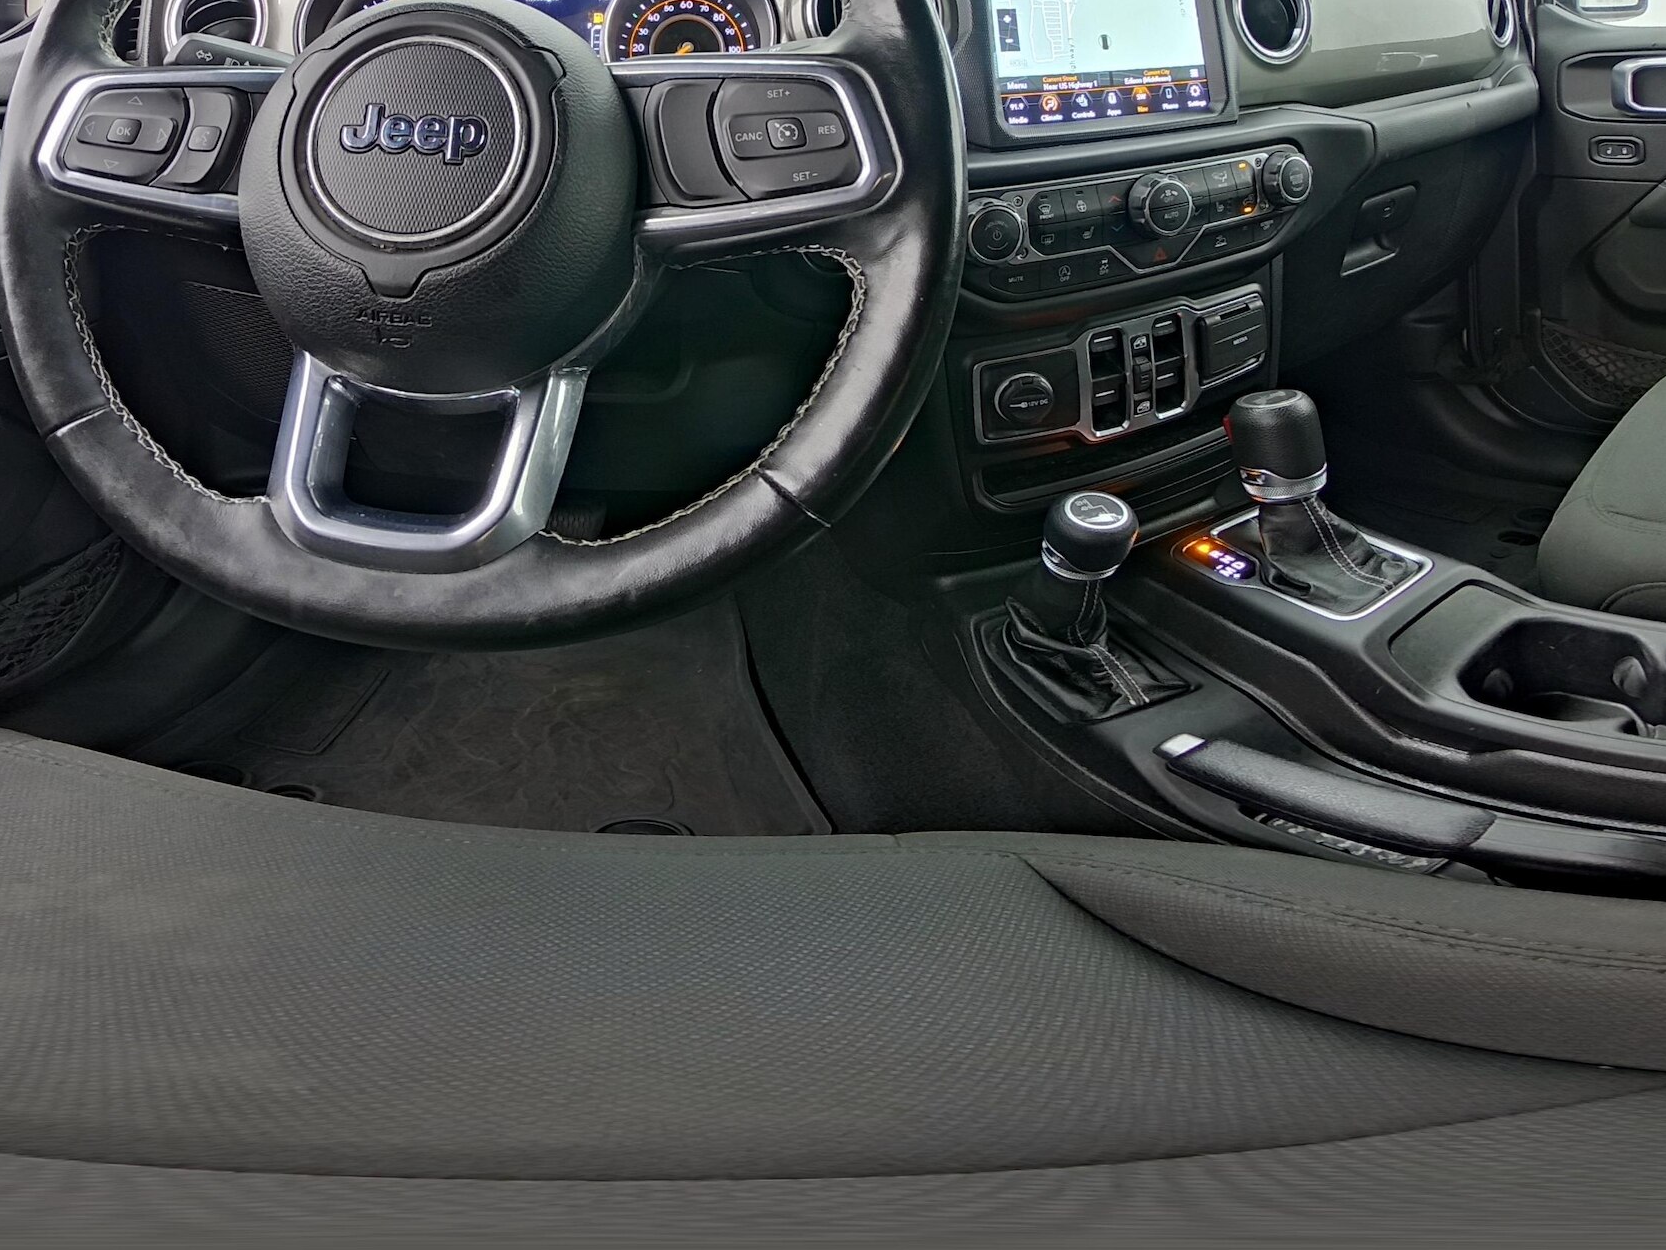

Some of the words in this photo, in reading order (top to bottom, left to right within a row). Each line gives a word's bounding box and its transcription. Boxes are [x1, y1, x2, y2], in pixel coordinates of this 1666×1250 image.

[664, 4, 675, 12] 50
[679, 0, 693, 9] 60
[699, 4, 710, 12] 70
[647, 13, 660, 22] 40
[713, 12, 725, 22] 80
[638, 27, 649, 36] 30
[724, 27, 735, 36] 90
[632, 43, 645, 52] 20
[728, 45, 741, 53] 100
[1007, 82, 1027, 90] Menu
[1043, 83, 1059, 91] Near
[1059, 82, 1068, 90] US
[1068, 80, 1093, 91] Highway
[1009, 102, 1025, 111] 91.9
[1041, 113, 1063, 122] Climate
[1072, 110, 1096, 119] Controls
[116, 125, 131, 137] OK
[340, 102, 491, 166] Jeep
[817, 125, 836, 135] RES
[735, 131, 764, 142] CANC
[1164, 211, 1180, 219] AUTO
[1008, 275, 1024, 283] MUTE
[1059, 274, 1071, 282] OFF
[1233, 336, 1248, 346] MEDIA
